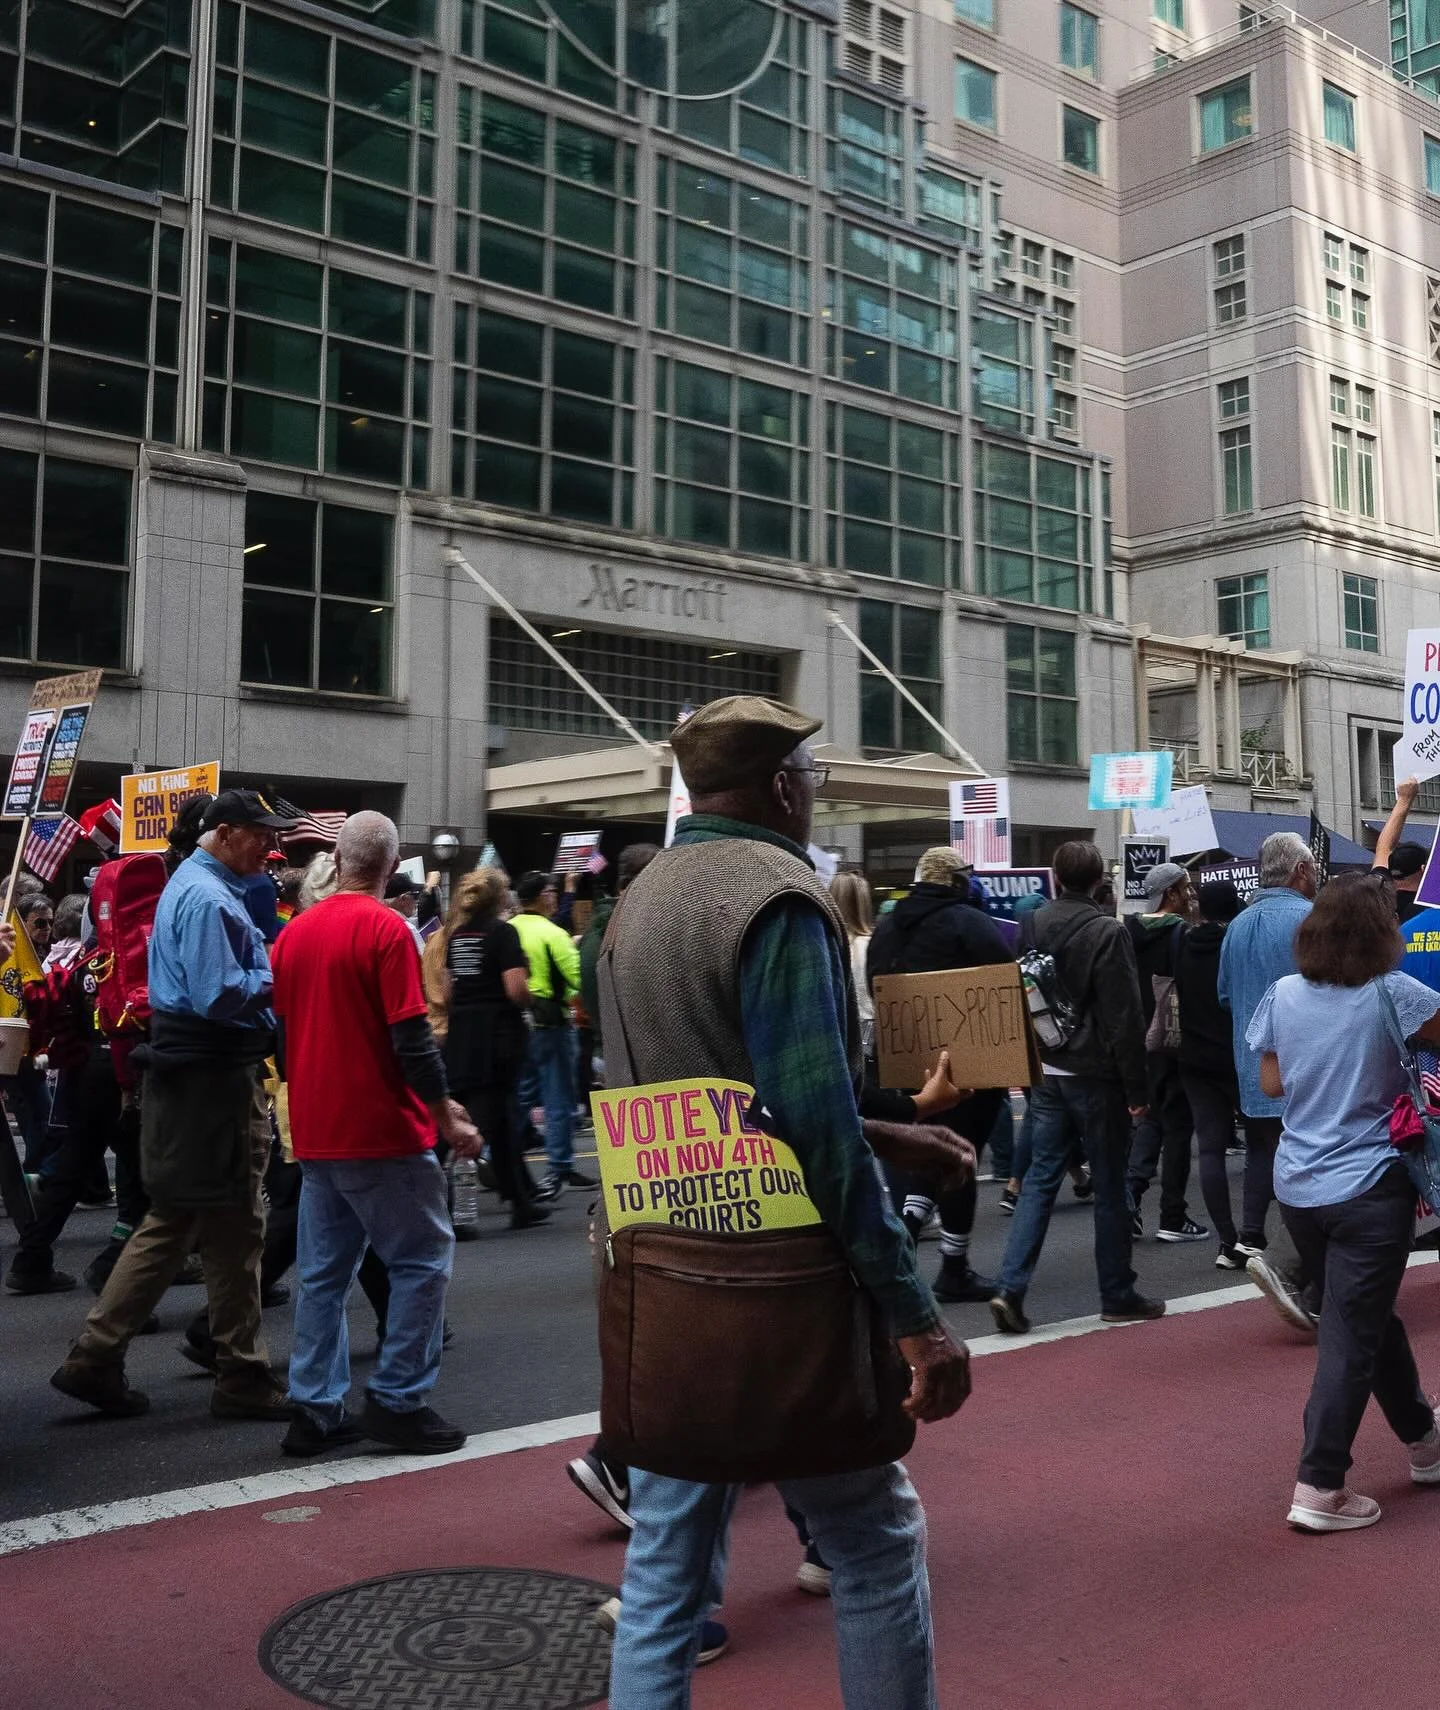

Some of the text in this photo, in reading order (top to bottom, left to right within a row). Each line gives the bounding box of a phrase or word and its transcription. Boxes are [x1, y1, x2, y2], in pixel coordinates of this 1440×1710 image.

[577, 564, 729, 623] Marriott
[1412, 729, 1440, 758] FROM
[138, 777, 157, 793] NO
[161, 772, 189, 791] KING
[134, 794, 164, 817] CAN
[135, 818, 167, 840] OUR
[1127, 880, 1140, 888] NO
[1200, 866, 1258, 883] HATE WILL
[978, 876, 1042, 897] RUMP
[1406, 942, 1424, 953] WITH
[1413, 932, 1426, 942] WE
[600, 1087, 762, 1148] VOTE YE
[636, 1137, 777, 1180] ON NOV 4TH
[613, 1167, 808, 1212] TO PROTECT OUR
[668, 1199, 762, 1232] COURTS
